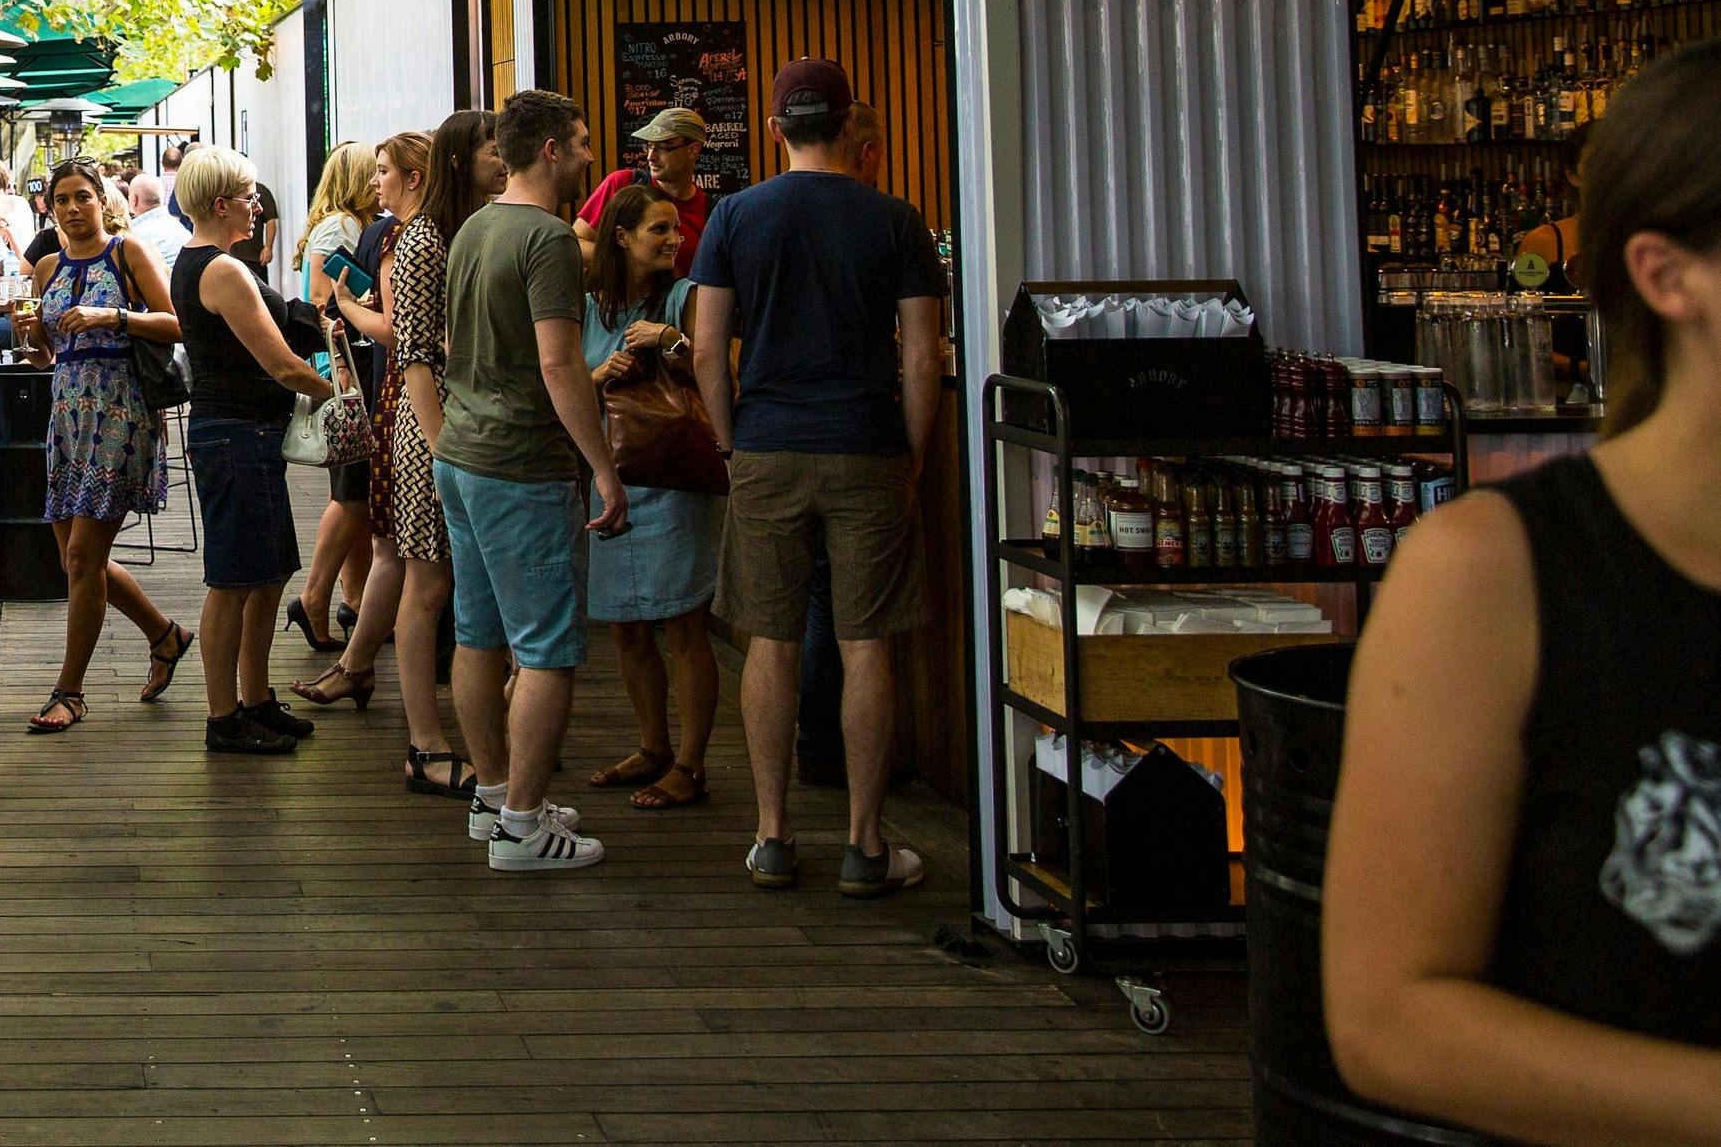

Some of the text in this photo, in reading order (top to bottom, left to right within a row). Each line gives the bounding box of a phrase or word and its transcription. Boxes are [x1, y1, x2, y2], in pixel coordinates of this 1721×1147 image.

[663, 32, 700, 45] ARBORY
[628, 42, 657, 53] NITRO
[622, 52, 667, 64] Espresso
[698, 48, 742, 69] APEROL
[654, 68, 668, 80] 16
[624, 97, 667, 108] Americano
[706, 122, 747, 133] BARREL
[710, 132, 739, 140] AGED
[703, 138, 739, 152] Negroni
[736, 168, 750, 180] 12
[28, 180, 43, 193] 100
[692, 174, 721, 189] ARE
[1119, 526, 1134, 534] HOT
